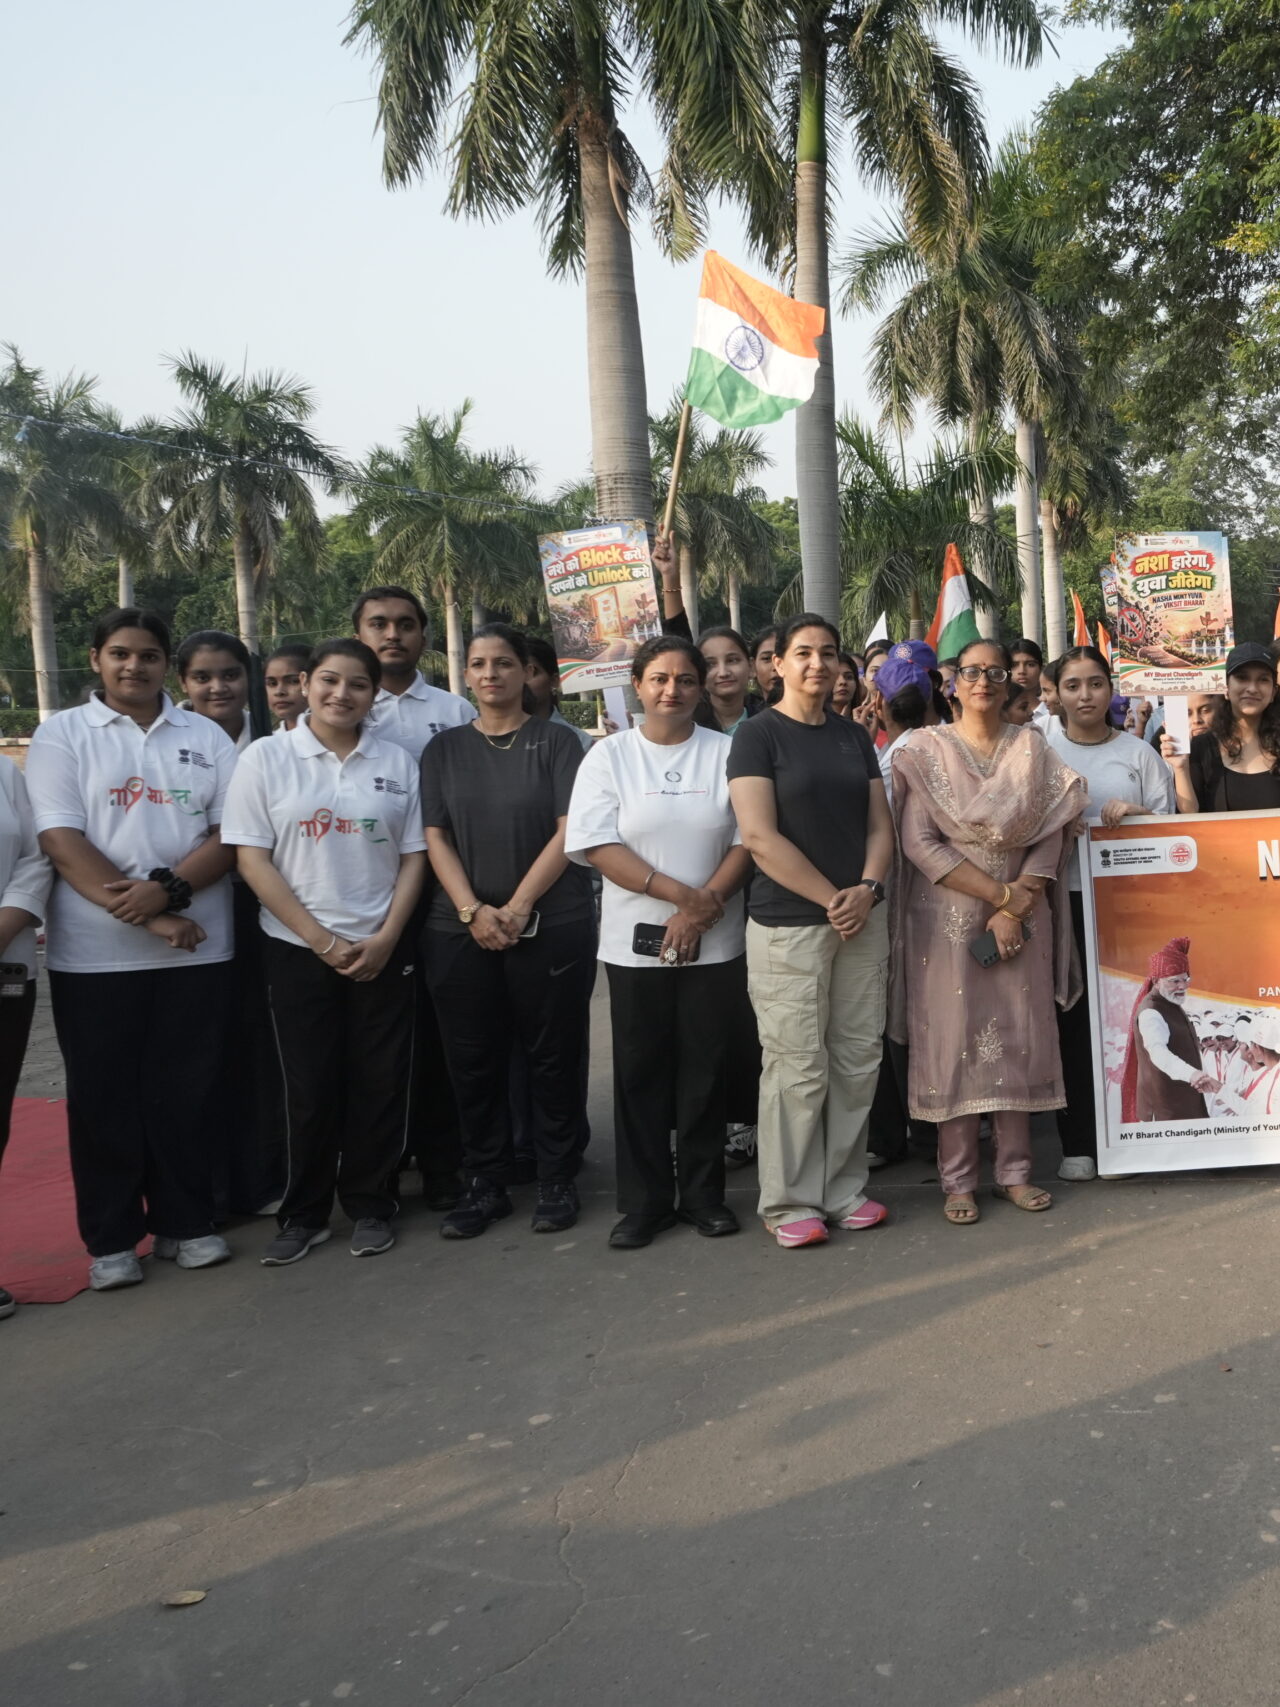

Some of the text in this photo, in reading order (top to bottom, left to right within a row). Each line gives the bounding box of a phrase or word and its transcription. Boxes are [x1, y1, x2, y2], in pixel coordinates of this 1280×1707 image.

[547, 557, 565, 577] नशे
[566, 556, 579, 571] को
[580, 545, 623, 570] Block
[1135, 551, 1210, 573] नशा हारेगा,
[551, 564, 650, 594] सपनों को Unlock करो
[1136, 571, 1212, 596] युवा जीतेगा
[1152, 595, 1172, 603] NASHA
[1163, 601, 1183, 609] VIKSIT
[1136, 1131, 1163, 1139] Bharat
[1165, 1127, 1211, 1139] Chandigarh
[1213, 1125, 1250, 1136] (Ministry
[1252, 1124, 1261, 1132] of
